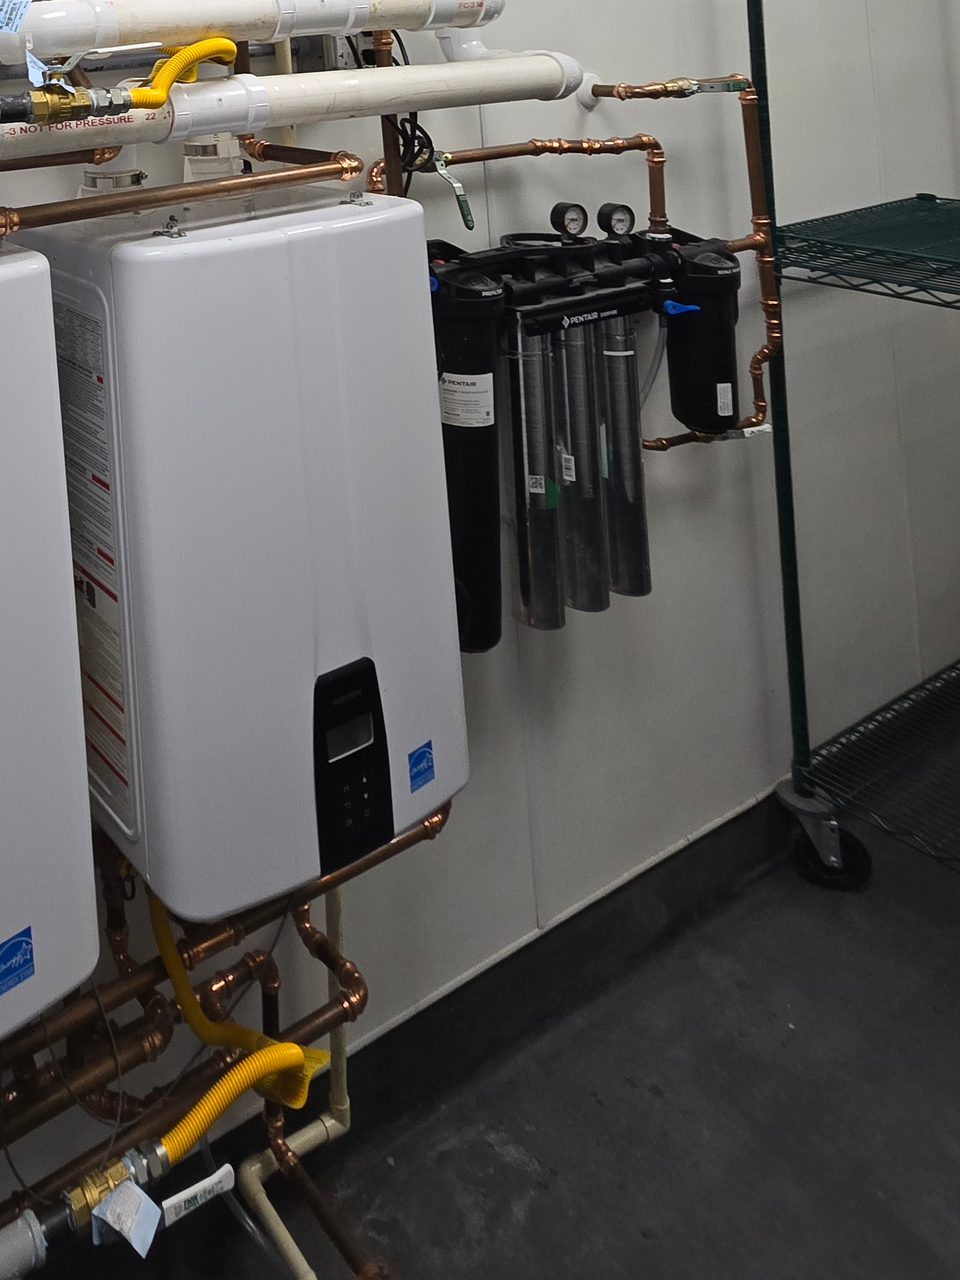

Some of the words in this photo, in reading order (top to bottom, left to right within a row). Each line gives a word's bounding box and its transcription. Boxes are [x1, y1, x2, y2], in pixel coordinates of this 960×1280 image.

[19, 123, 44, 135] NOT
[48, 121, 72, 132] FOR
[75, 114, 135, 129] PRESSURE
[144, 112, 156, 121] 22
[570, 311, 599, 325] PENTAIR
[447, 379, 477, 387] PENTAIR
